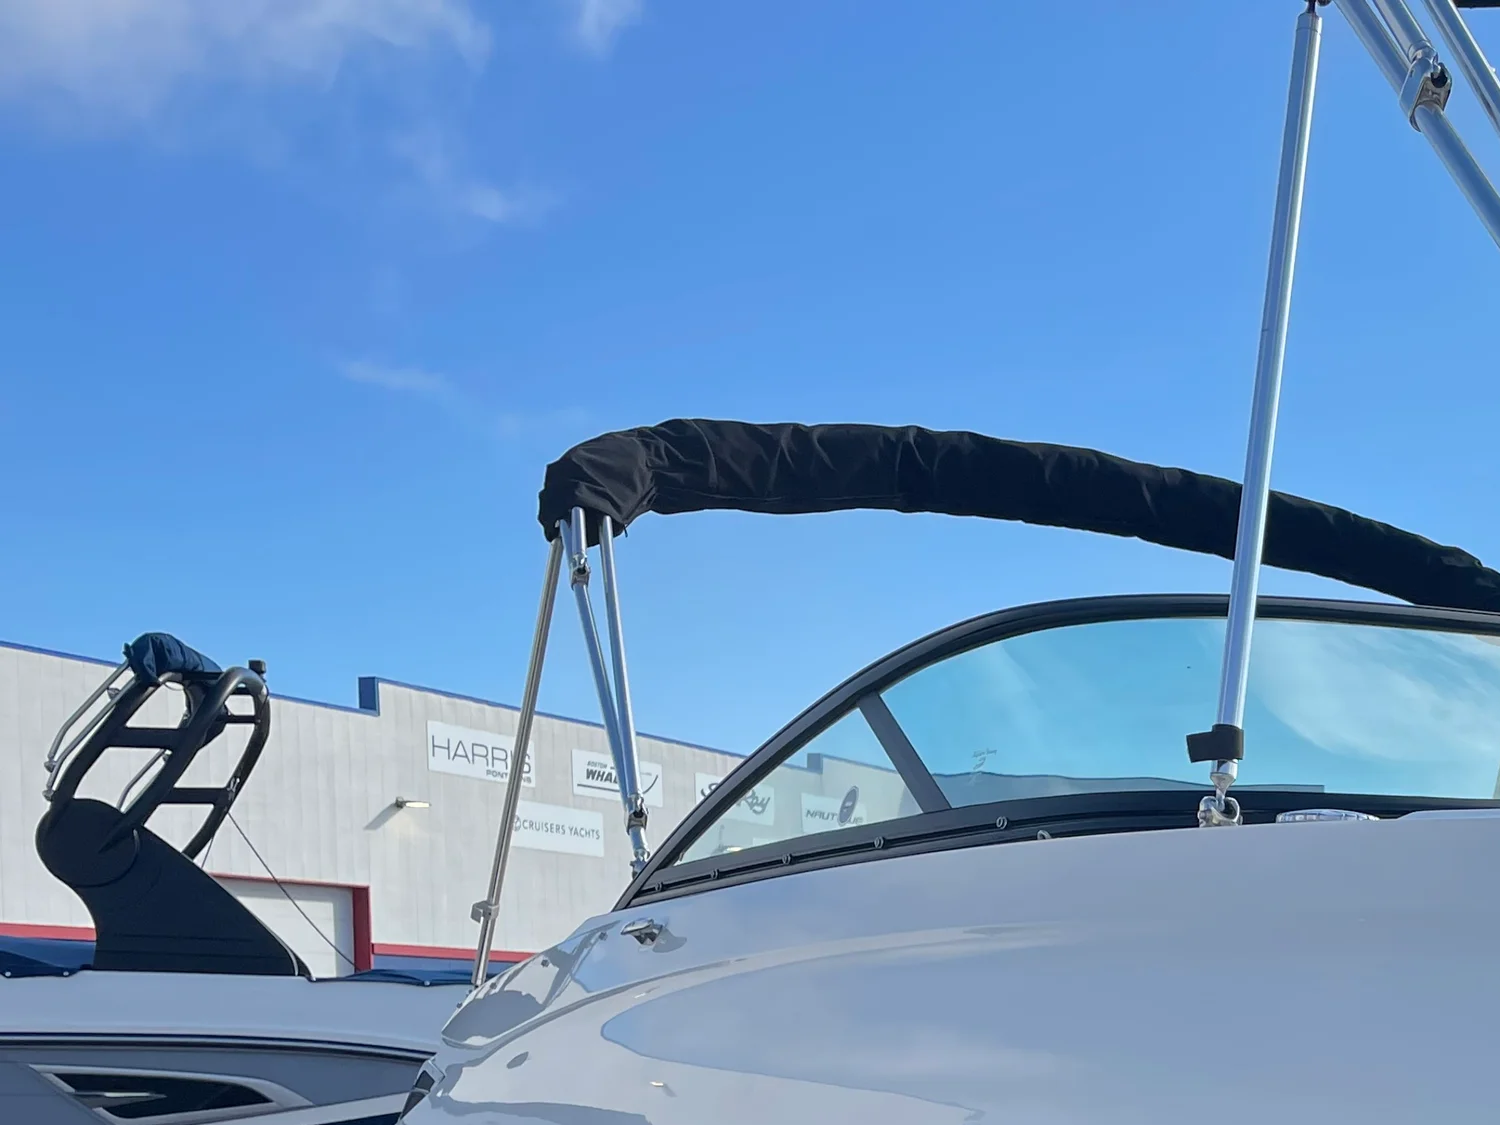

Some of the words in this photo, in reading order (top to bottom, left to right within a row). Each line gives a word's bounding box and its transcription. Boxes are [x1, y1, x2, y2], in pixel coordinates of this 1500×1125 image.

[486, 769, 532, 784] PONTNS
[585, 768, 618, 784] WHAL
[805, 809, 863, 825] NAUTUE
[522, 819, 566, 835] CRUISERS
[568, 825, 601, 840] YACHTS
